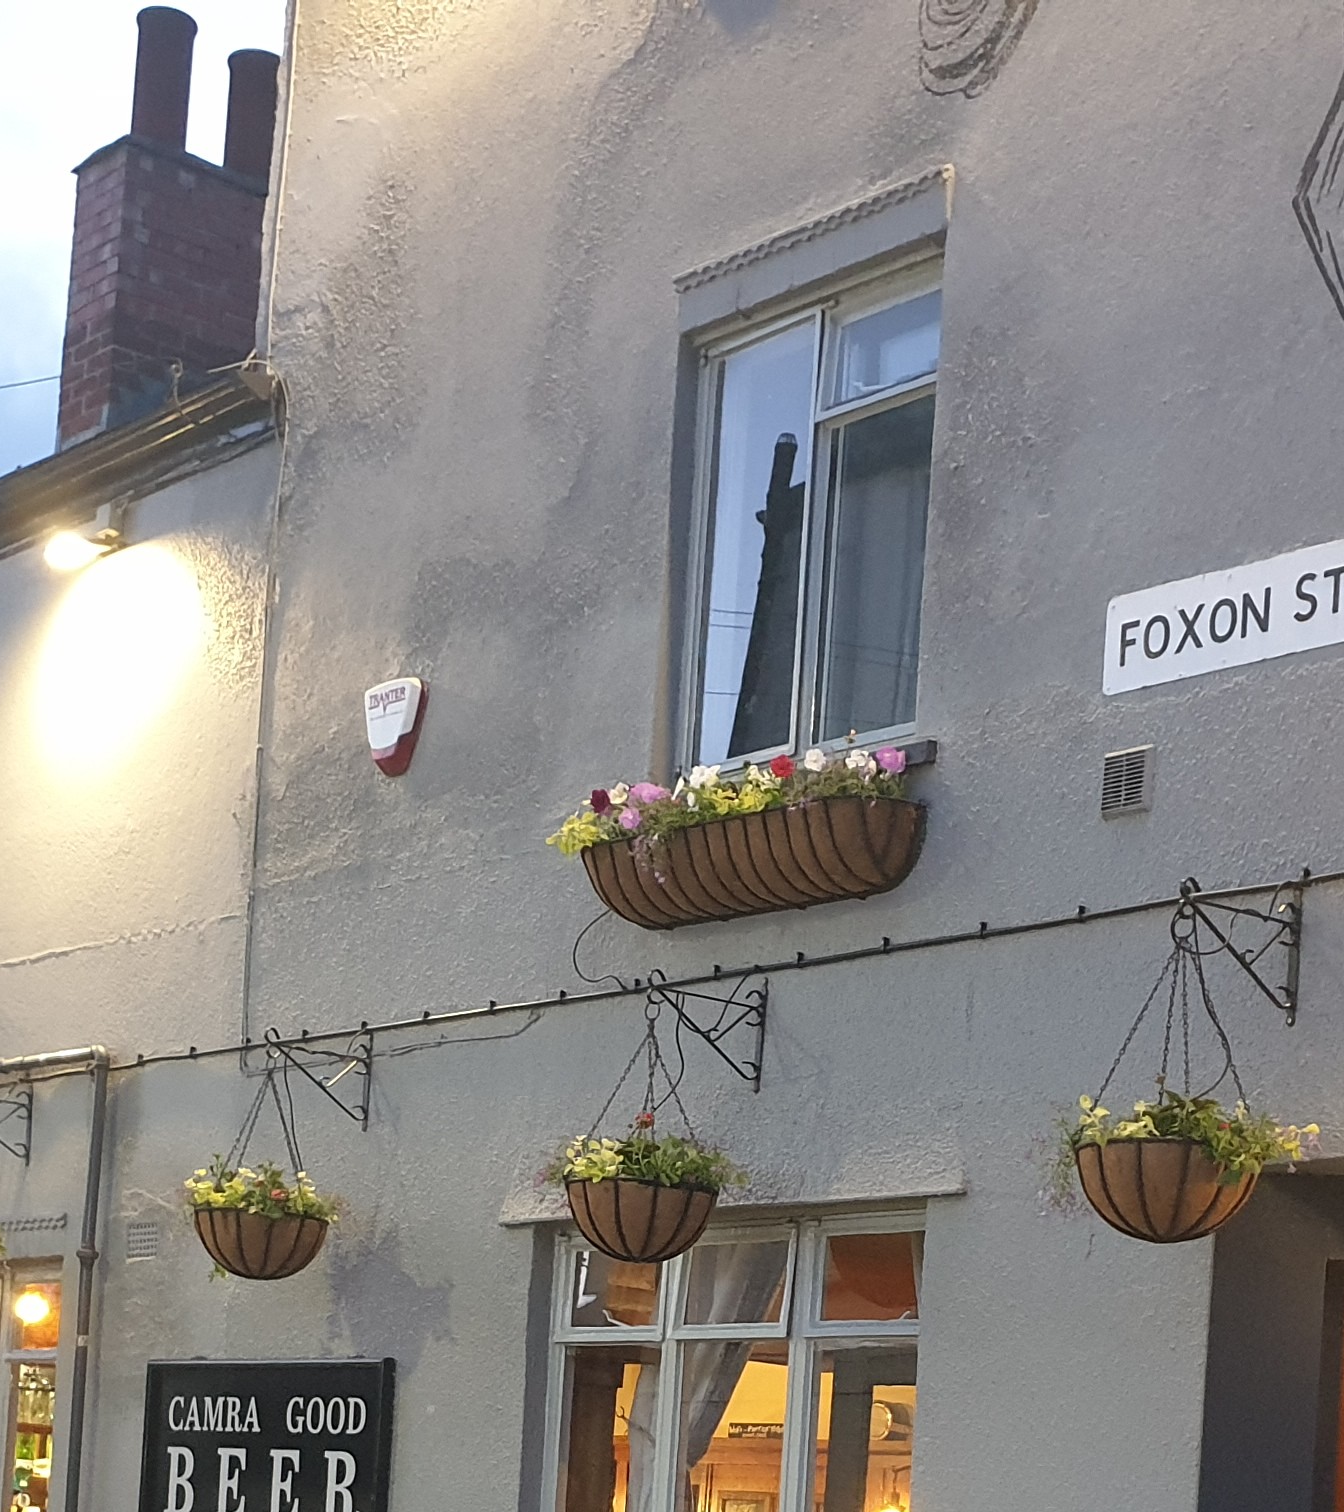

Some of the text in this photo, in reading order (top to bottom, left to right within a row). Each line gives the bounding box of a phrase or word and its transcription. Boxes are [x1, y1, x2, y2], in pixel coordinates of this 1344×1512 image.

[1119, 587, 1272, 668] FOXON
[168, 1396, 367, 1435] CAMRA GOOD
